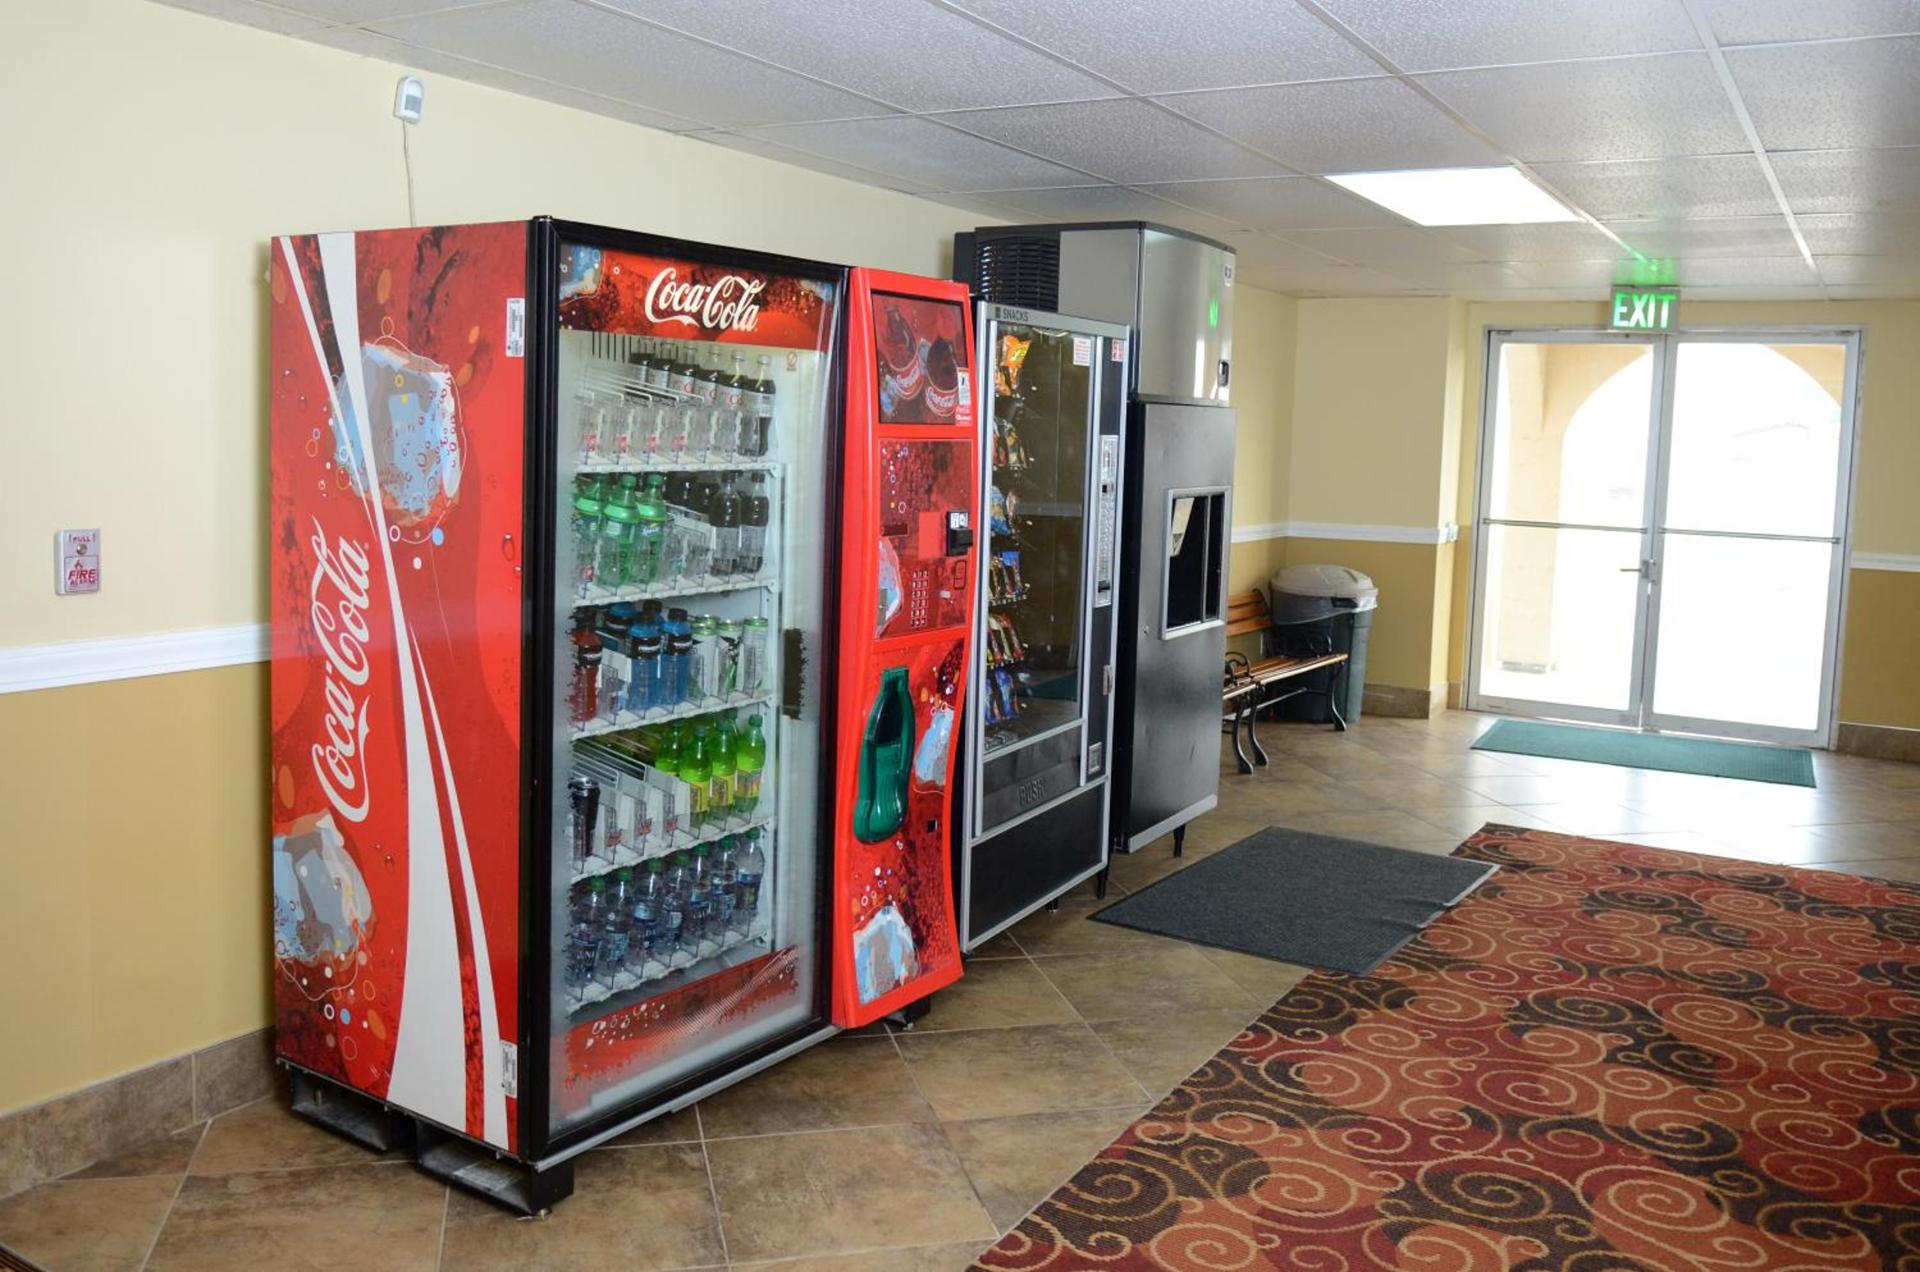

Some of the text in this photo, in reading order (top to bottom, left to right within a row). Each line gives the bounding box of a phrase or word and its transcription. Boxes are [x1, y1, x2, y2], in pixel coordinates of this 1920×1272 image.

[645, 267, 767, 332] Coca-Cola
[1003, 308, 1029, 321] SNACKS
[1613, 293, 1677, 329] EXIT
[68, 569, 96, 580] FIRE
[311, 513, 370, 823] Coca-Cola
